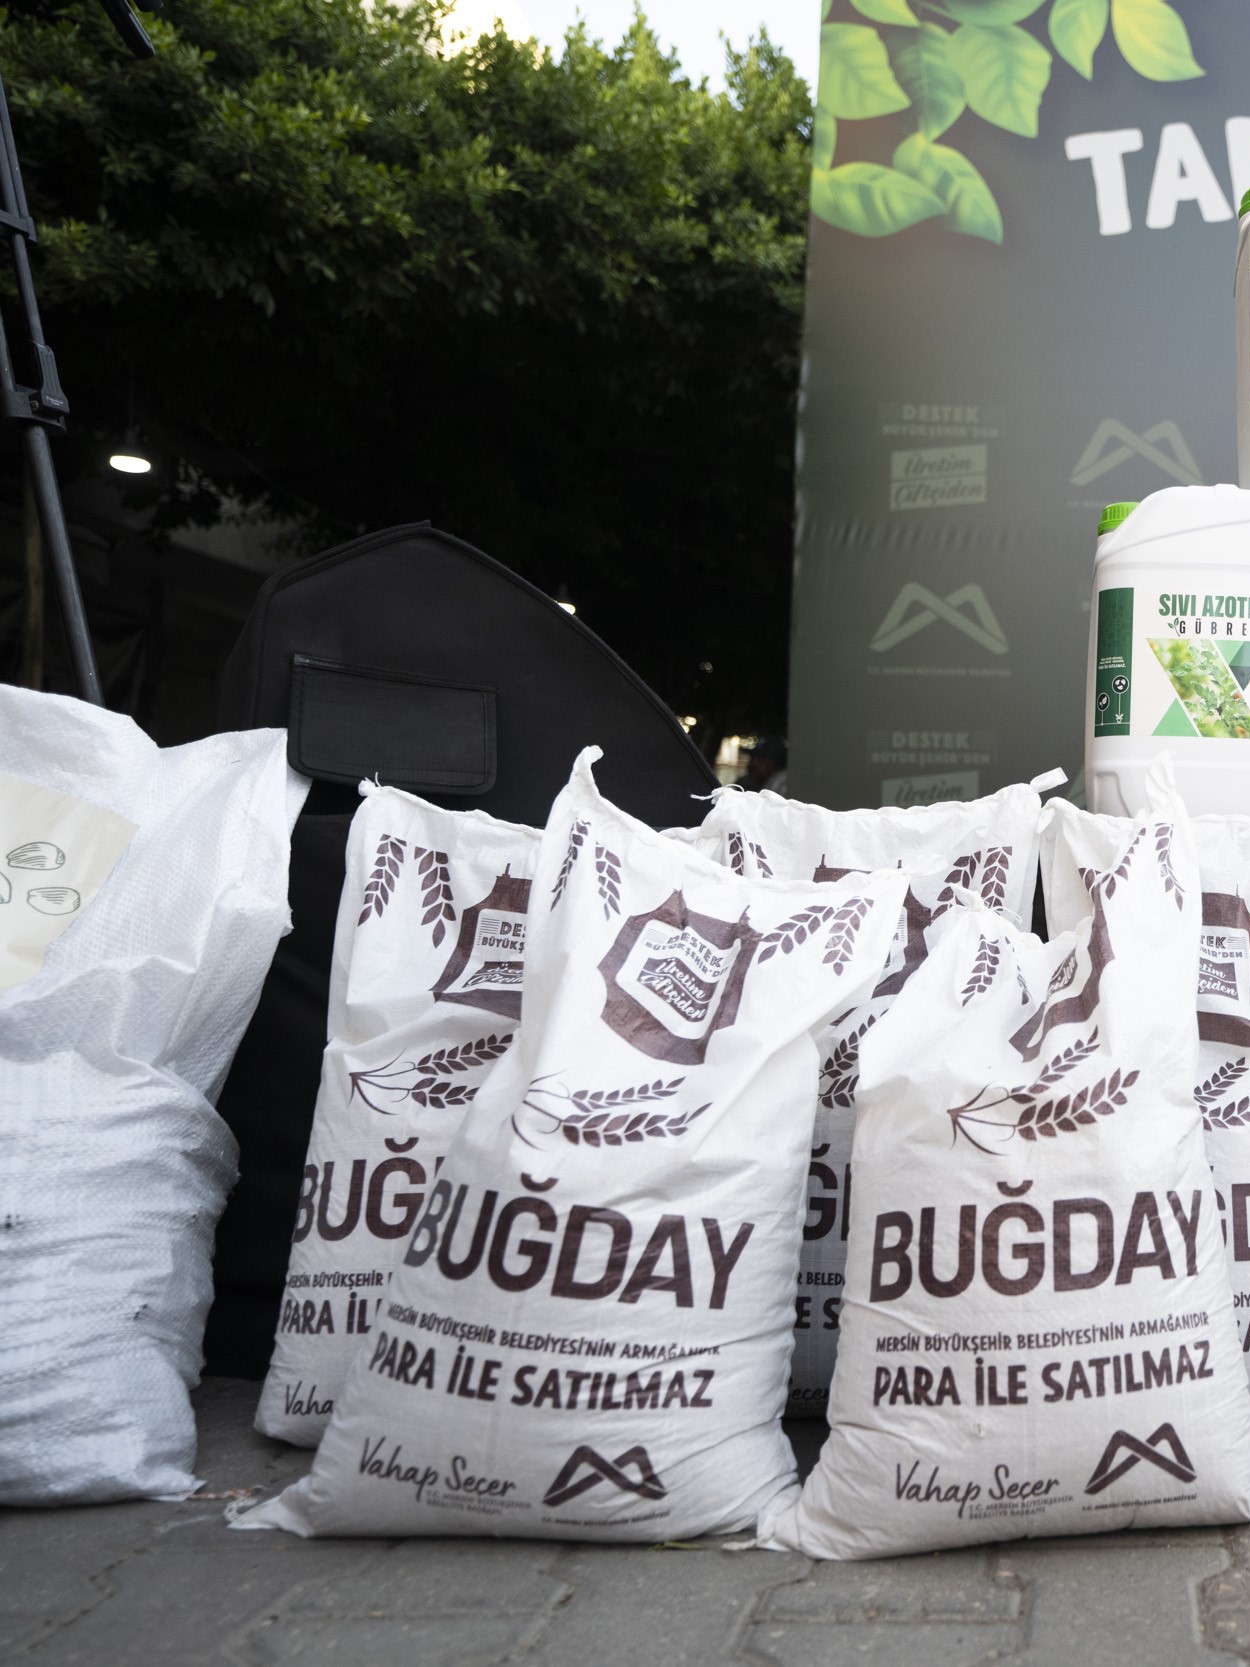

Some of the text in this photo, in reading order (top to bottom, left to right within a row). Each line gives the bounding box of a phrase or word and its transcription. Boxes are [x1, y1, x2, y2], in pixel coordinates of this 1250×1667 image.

[901, 405, 979, 423] DESTEK
[1158, 594, 1196, 617] SIVI
[1179, 617, 1248, 636] GÜBRE
[891, 731, 970, 749] DESTEK
[667, 932, 724, 968] DESTEK
[641, 975, 706, 1019] Çiftçiden
[655, 958, 706, 999] Üretim
[403, 1172, 755, 1310] BUĞDAY
[869, 1180, 1202, 1303] BUĞDAY
[312, 1269, 384, 1290] BÜYÜKŞEHİR
[281, 1299, 335, 1335] PARA
[418, 1311, 497, 1345] BÜYÜKŞEHİR
[499, 1331, 616, 1358] BELEDİYESİ'NİN
[876, 1311, 1209, 1355] MERSİN BÜYÜKŞEHİR BELEDİYESİ'NİN ARMAĞANIDIR
[370, 1331, 716, 1411] PARA İLE SATILMAZ
[873, 1340, 1215, 1407] PARA İLE SATILMAZ
[358, 1436, 518, 1502] Vahap Seçer
[896, 1459, 1061, 1520] Vahap Seçer
